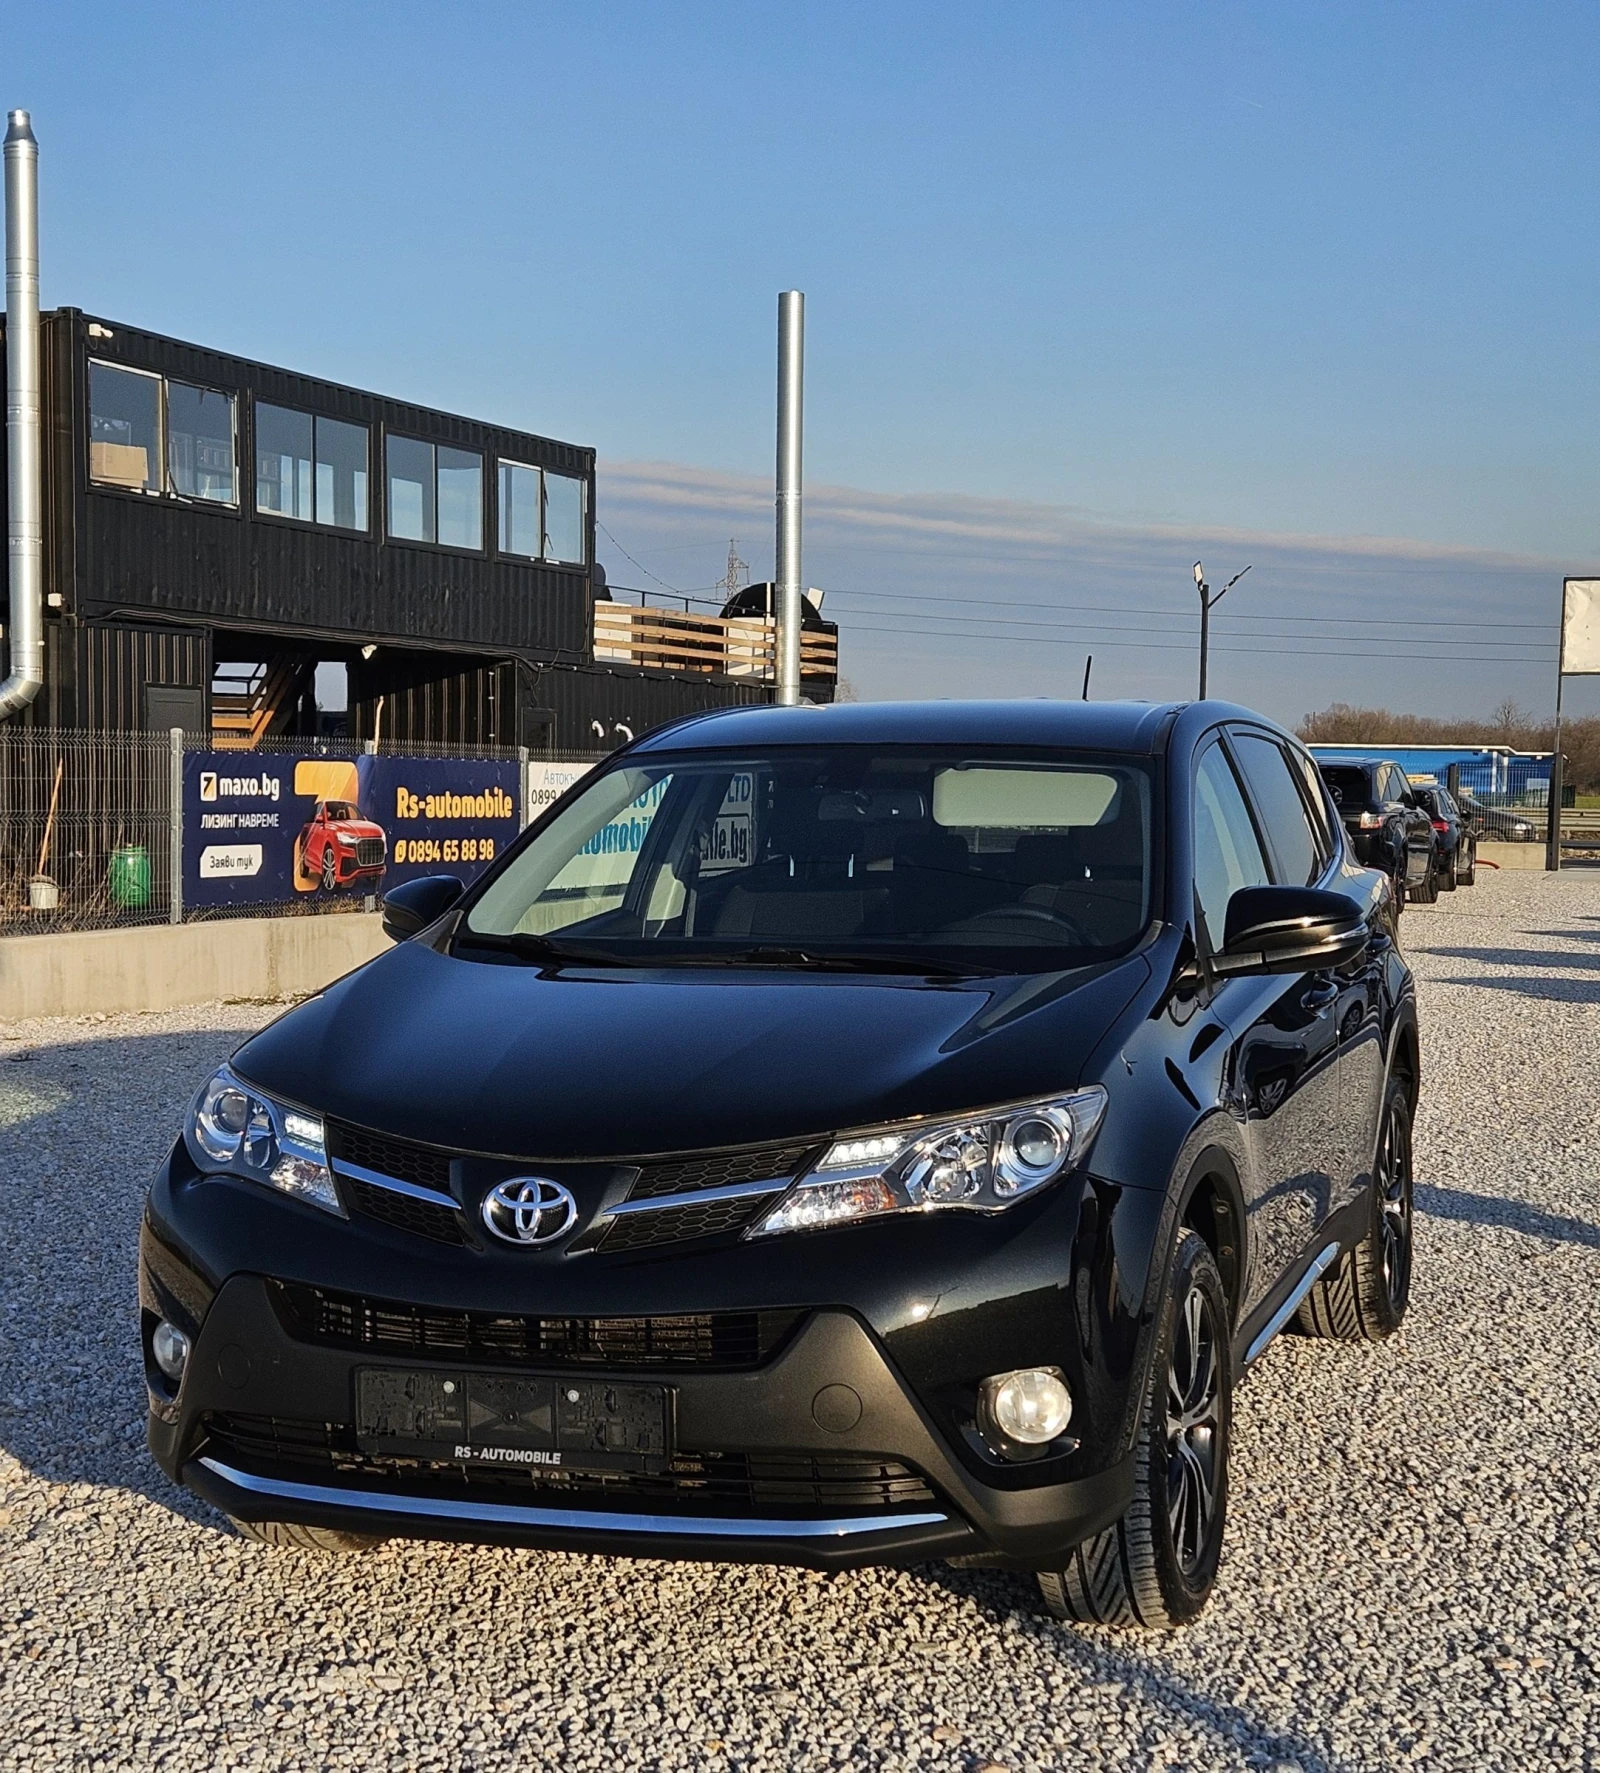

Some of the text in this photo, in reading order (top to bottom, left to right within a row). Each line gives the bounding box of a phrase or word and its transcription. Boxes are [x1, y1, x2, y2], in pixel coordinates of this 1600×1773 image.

[219, 772, 280, 801] maxo.bg
[397, 786, 512, 818] Rs-automobile
[201, 813, 279, 829] ЛИЗИНГ НАВРЕМЕ
[408, 838, 494, 863] 0894 65 88 98
[209, 854, 254, 870] Заяви тук
[454, 1445, 471, 1458] RS
[480, 1447, 562, 1465] AUTOMOBILE
